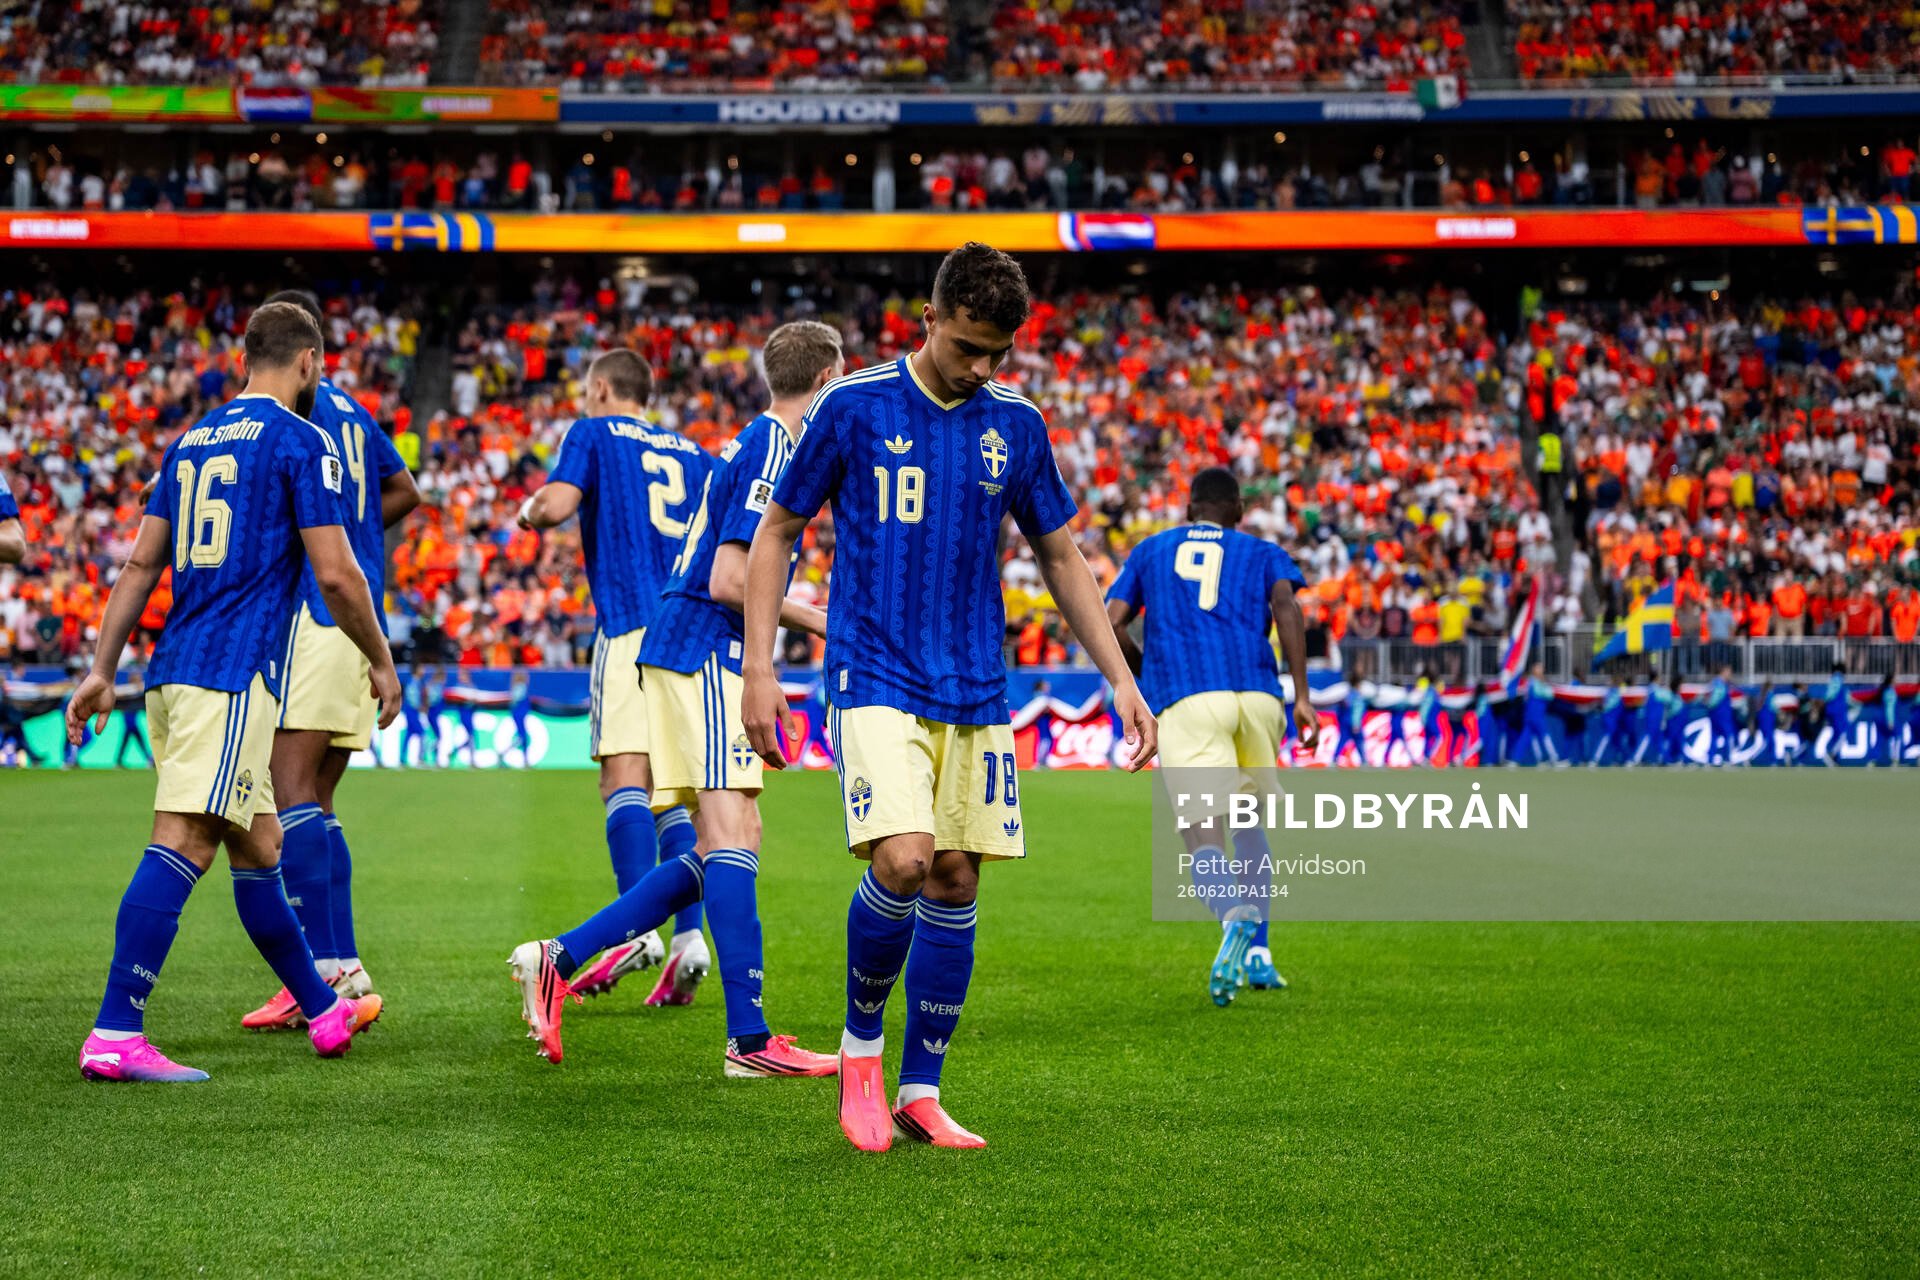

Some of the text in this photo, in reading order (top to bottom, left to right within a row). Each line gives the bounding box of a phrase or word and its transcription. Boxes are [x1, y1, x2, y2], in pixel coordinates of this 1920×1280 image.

[718, 101, 900, 122] HOUSTON
[341, 421, 366, 523] 4
[641, 450, 687, 539] 2
[873, 466, 926, 524] 18
[175, 454, 238, 572] 16
[1174, 541, 1224, 611] 9
[983, 751, 1017, 808] 18
